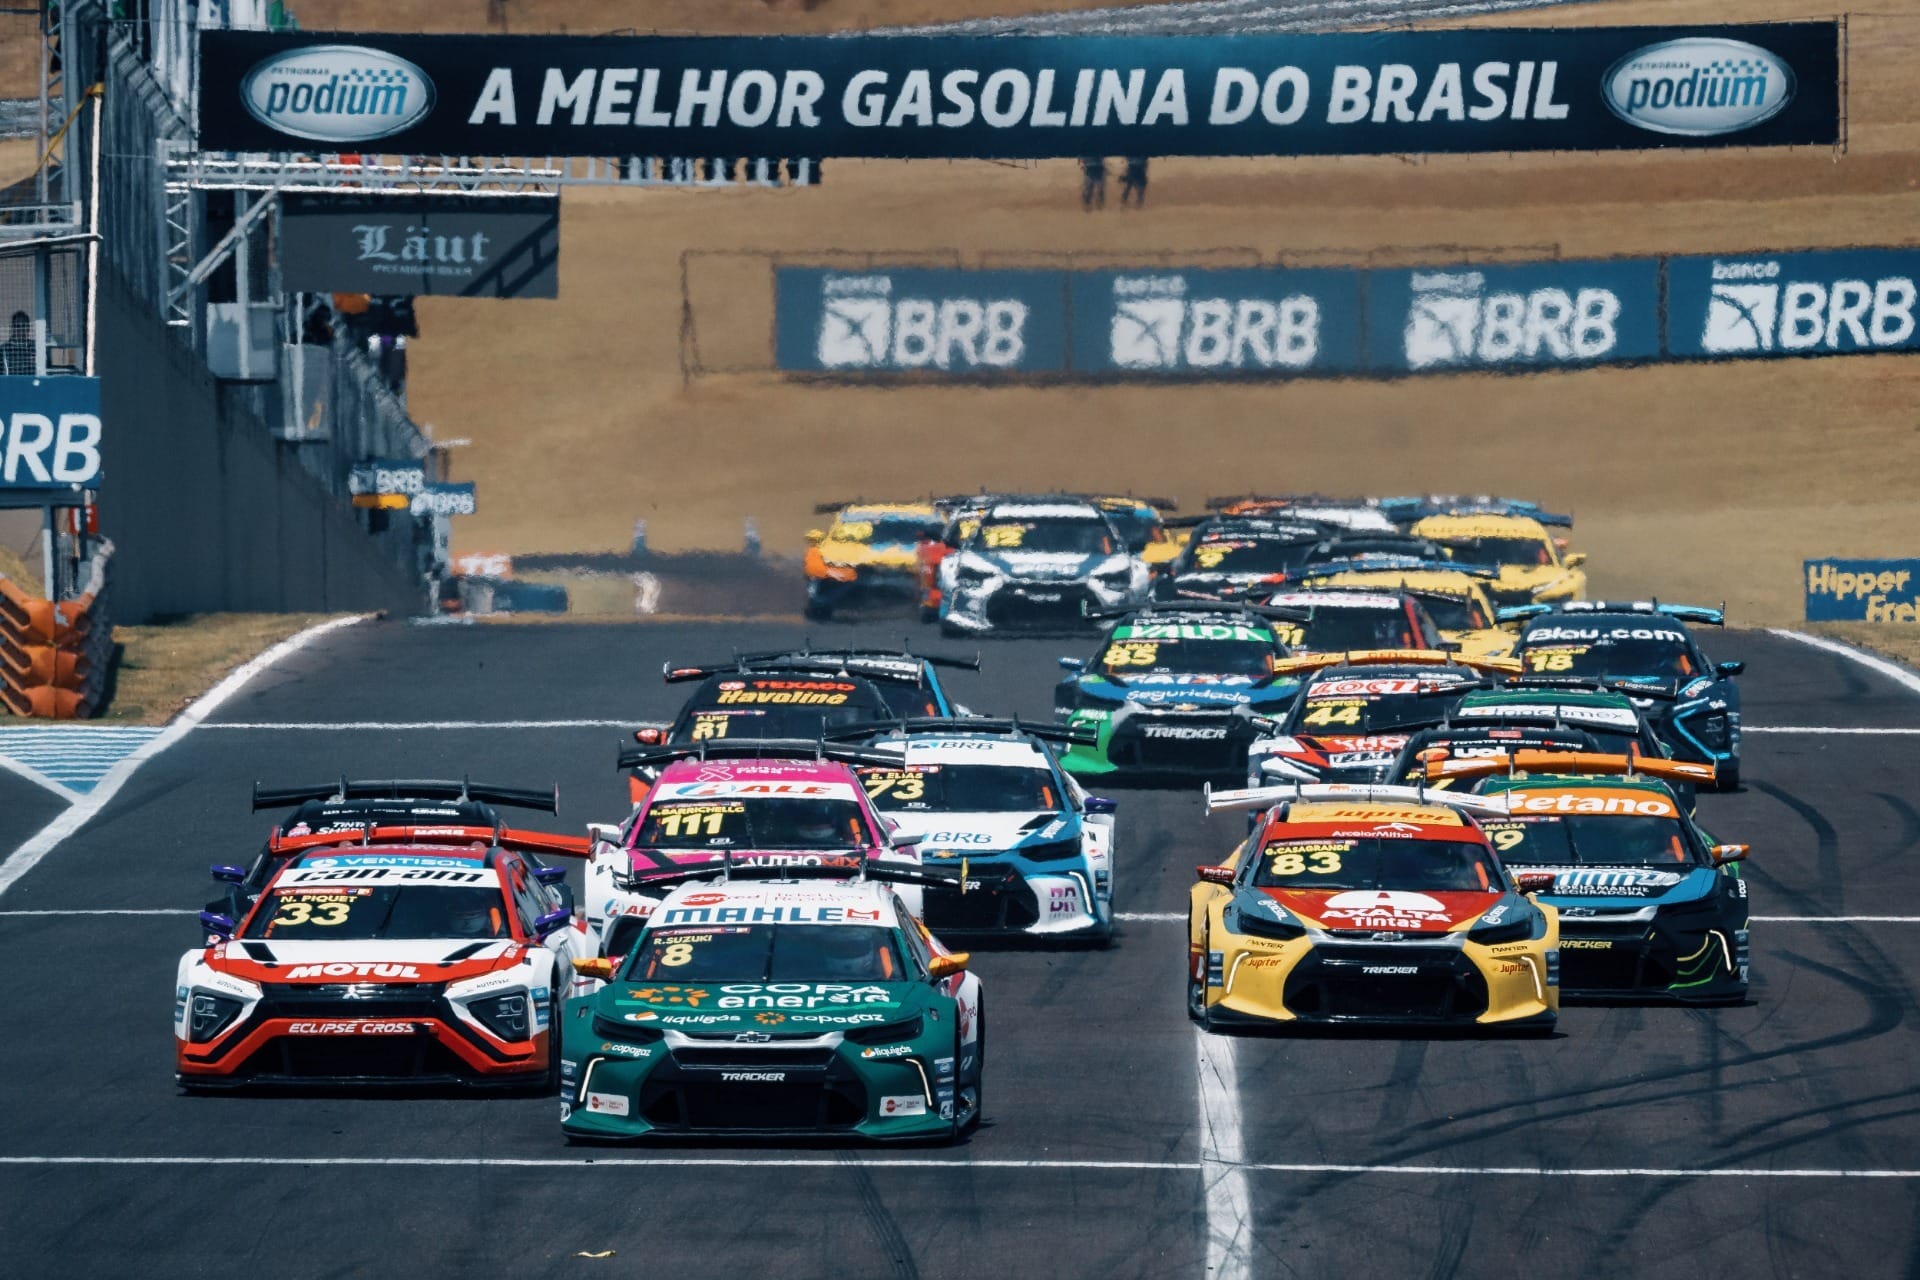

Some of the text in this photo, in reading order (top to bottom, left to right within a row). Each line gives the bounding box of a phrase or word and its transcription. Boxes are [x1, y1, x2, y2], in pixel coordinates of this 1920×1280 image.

[266, 74, 408, 117] podium
[468, 60, 1570, 128] A MELHOR GASOLINA DO BRASIL
[1626, 68, 1768, 114] podium
[1779, 277, 1917, 350] BRB
[895, 298, 1030, 368] BRB
[1185, 294, 1320, 367] BRB
[1478, 288, 1622, 362] BRB
[0, 413, 101, 482] RB
[1809, 564, 1911, 600] Hipper
[1527, 627, 1686, 643] Blau.com
[1103, 648, 1157, 666] 85
[1531, 655, 1574, 672] 18
[753, 680, 856, 691] TEXACO
[717, 689, 849, 705] Havoline
[1304, 706, 1361, 726] 44
[1143, 725, 1227, 739] TRACKER
[940, 740, 994, 751] BRB
[735, 784, 832, 795] ALE
[865, 779, 925, 800] 73
[661, 812, 724, 837] 111
[931, 831, 993, 845] BRB
[1332, 829, 1413, 839] ArcelorMittal
[1264, 844, 1351, 856] G.CASAGRANDE
[344, 856, 473, 868] VENTISOL
[1270, 851, 1342, 875] 83
[293, 867, 485, 883] can-am
[279, 895, 358, 903] N. PIQUET
[273, 902, 351, 926] 33
[664, 907, 844, 924] MAHLE
[1320, 908, 1452, 923] AXALTA
[1351, 916, 1422, 929] Tintas
[653, 934, 713, 945] R.SUZUKI
[1558, 940, 1613, 949] RACKER
[660, 943, 694, 967] 8
[285, 962, 421, 979] MOTUL
[1362, 966, 1418, 974] TRACKER
[720, 984, 890, 996] COPA
[791, 1013, 886, 1024] copagaz
[288, 1023, 415, 1034] ECLIPSE CROSS
[611, 1044, 652, 1058] copagaz
[721, 1072, 786, 1082] TRACKER
